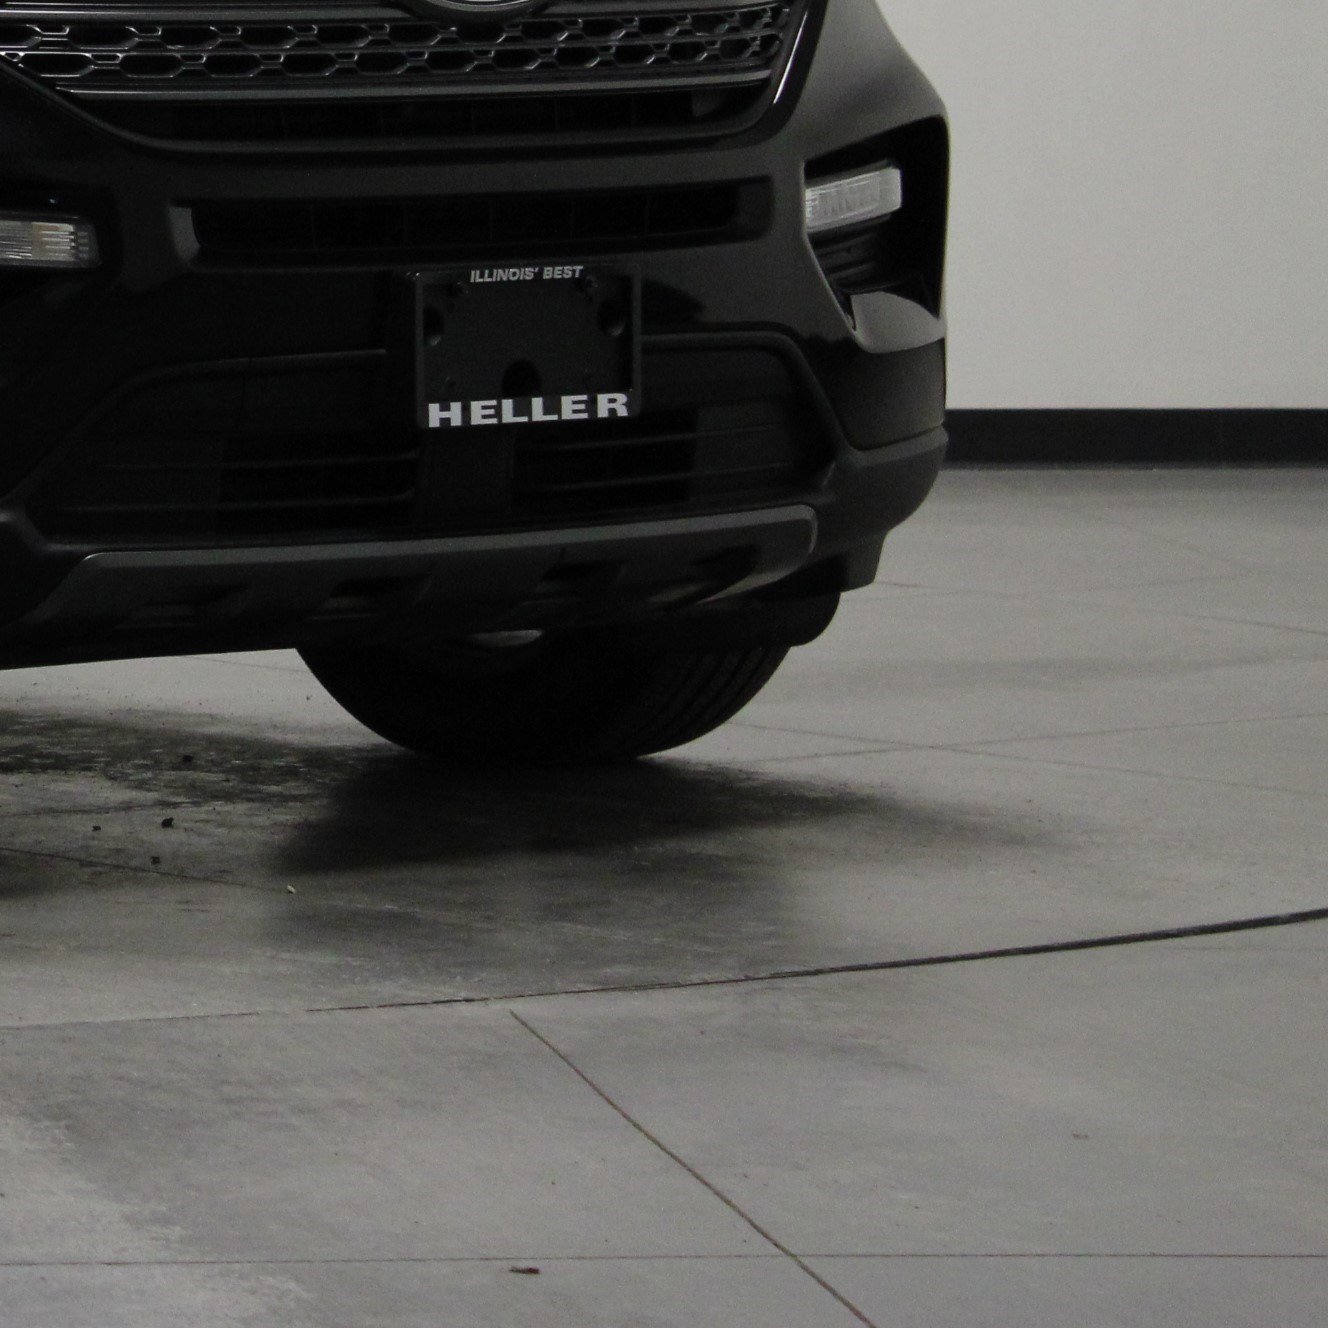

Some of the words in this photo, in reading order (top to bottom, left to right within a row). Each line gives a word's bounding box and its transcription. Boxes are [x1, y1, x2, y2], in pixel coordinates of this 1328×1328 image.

[470, 267, 539, 283] ILLINOIS'
[543, 265, 584, 280] BEST
[428, 392, 629, 428] HELLER
